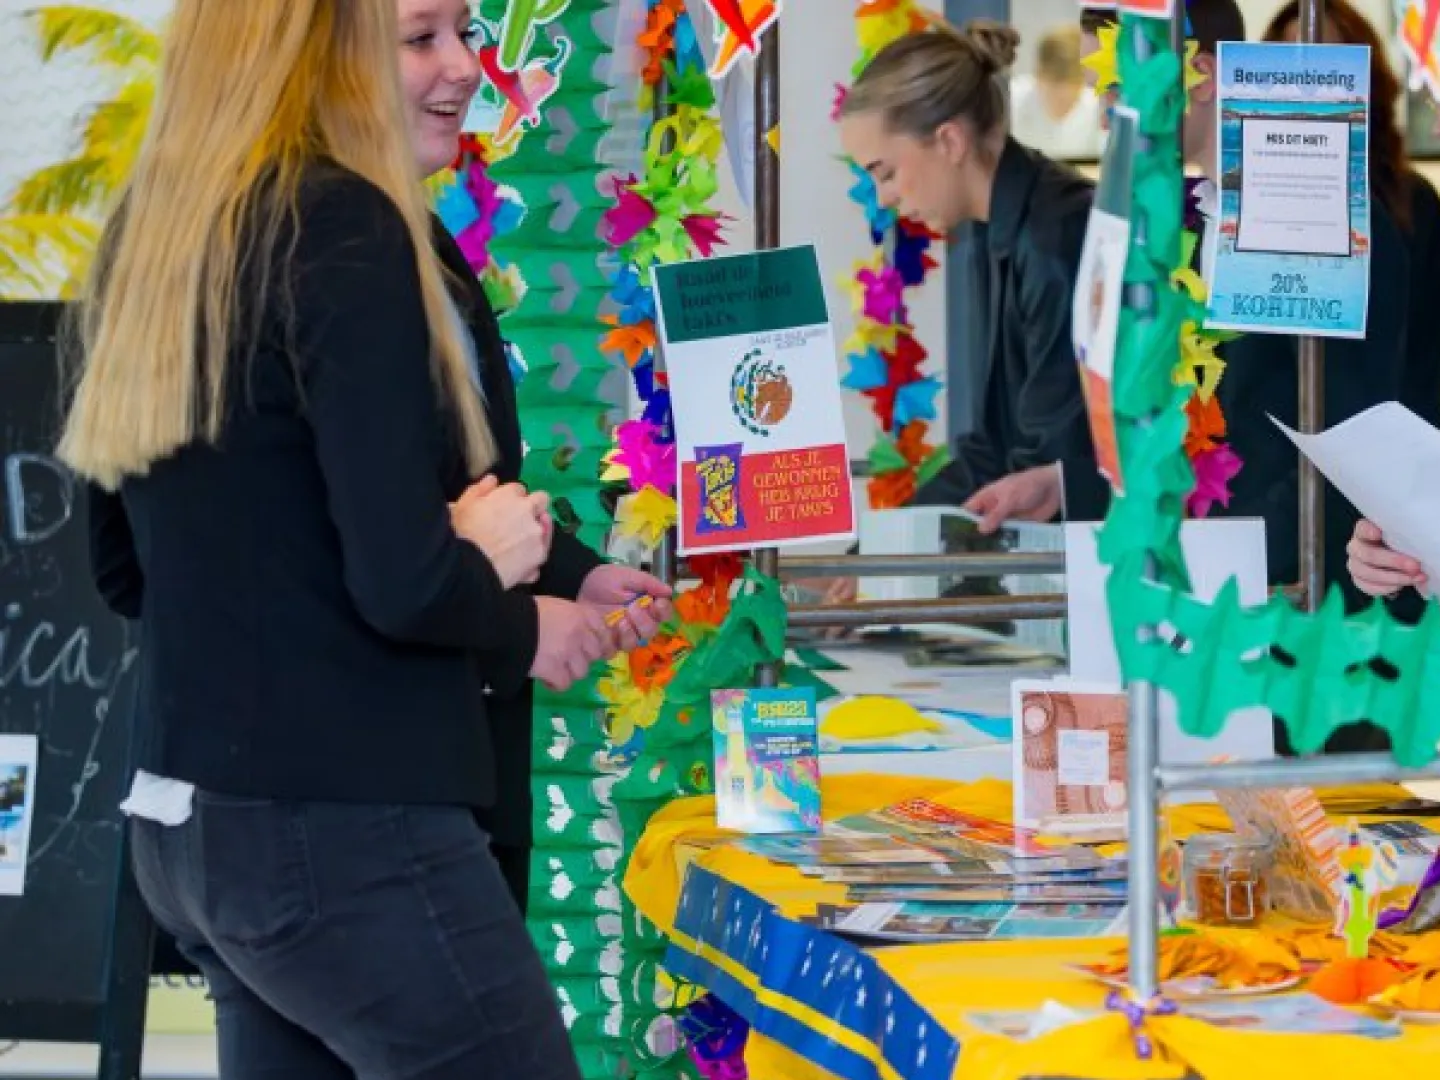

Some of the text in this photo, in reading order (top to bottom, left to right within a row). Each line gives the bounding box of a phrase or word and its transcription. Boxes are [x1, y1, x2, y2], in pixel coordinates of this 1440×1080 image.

[1233, 68, 1355, 91] Beursaanbieding
[1231, 294, 1343, 321] KORTING
[772, 453, 800, 469] ALS
